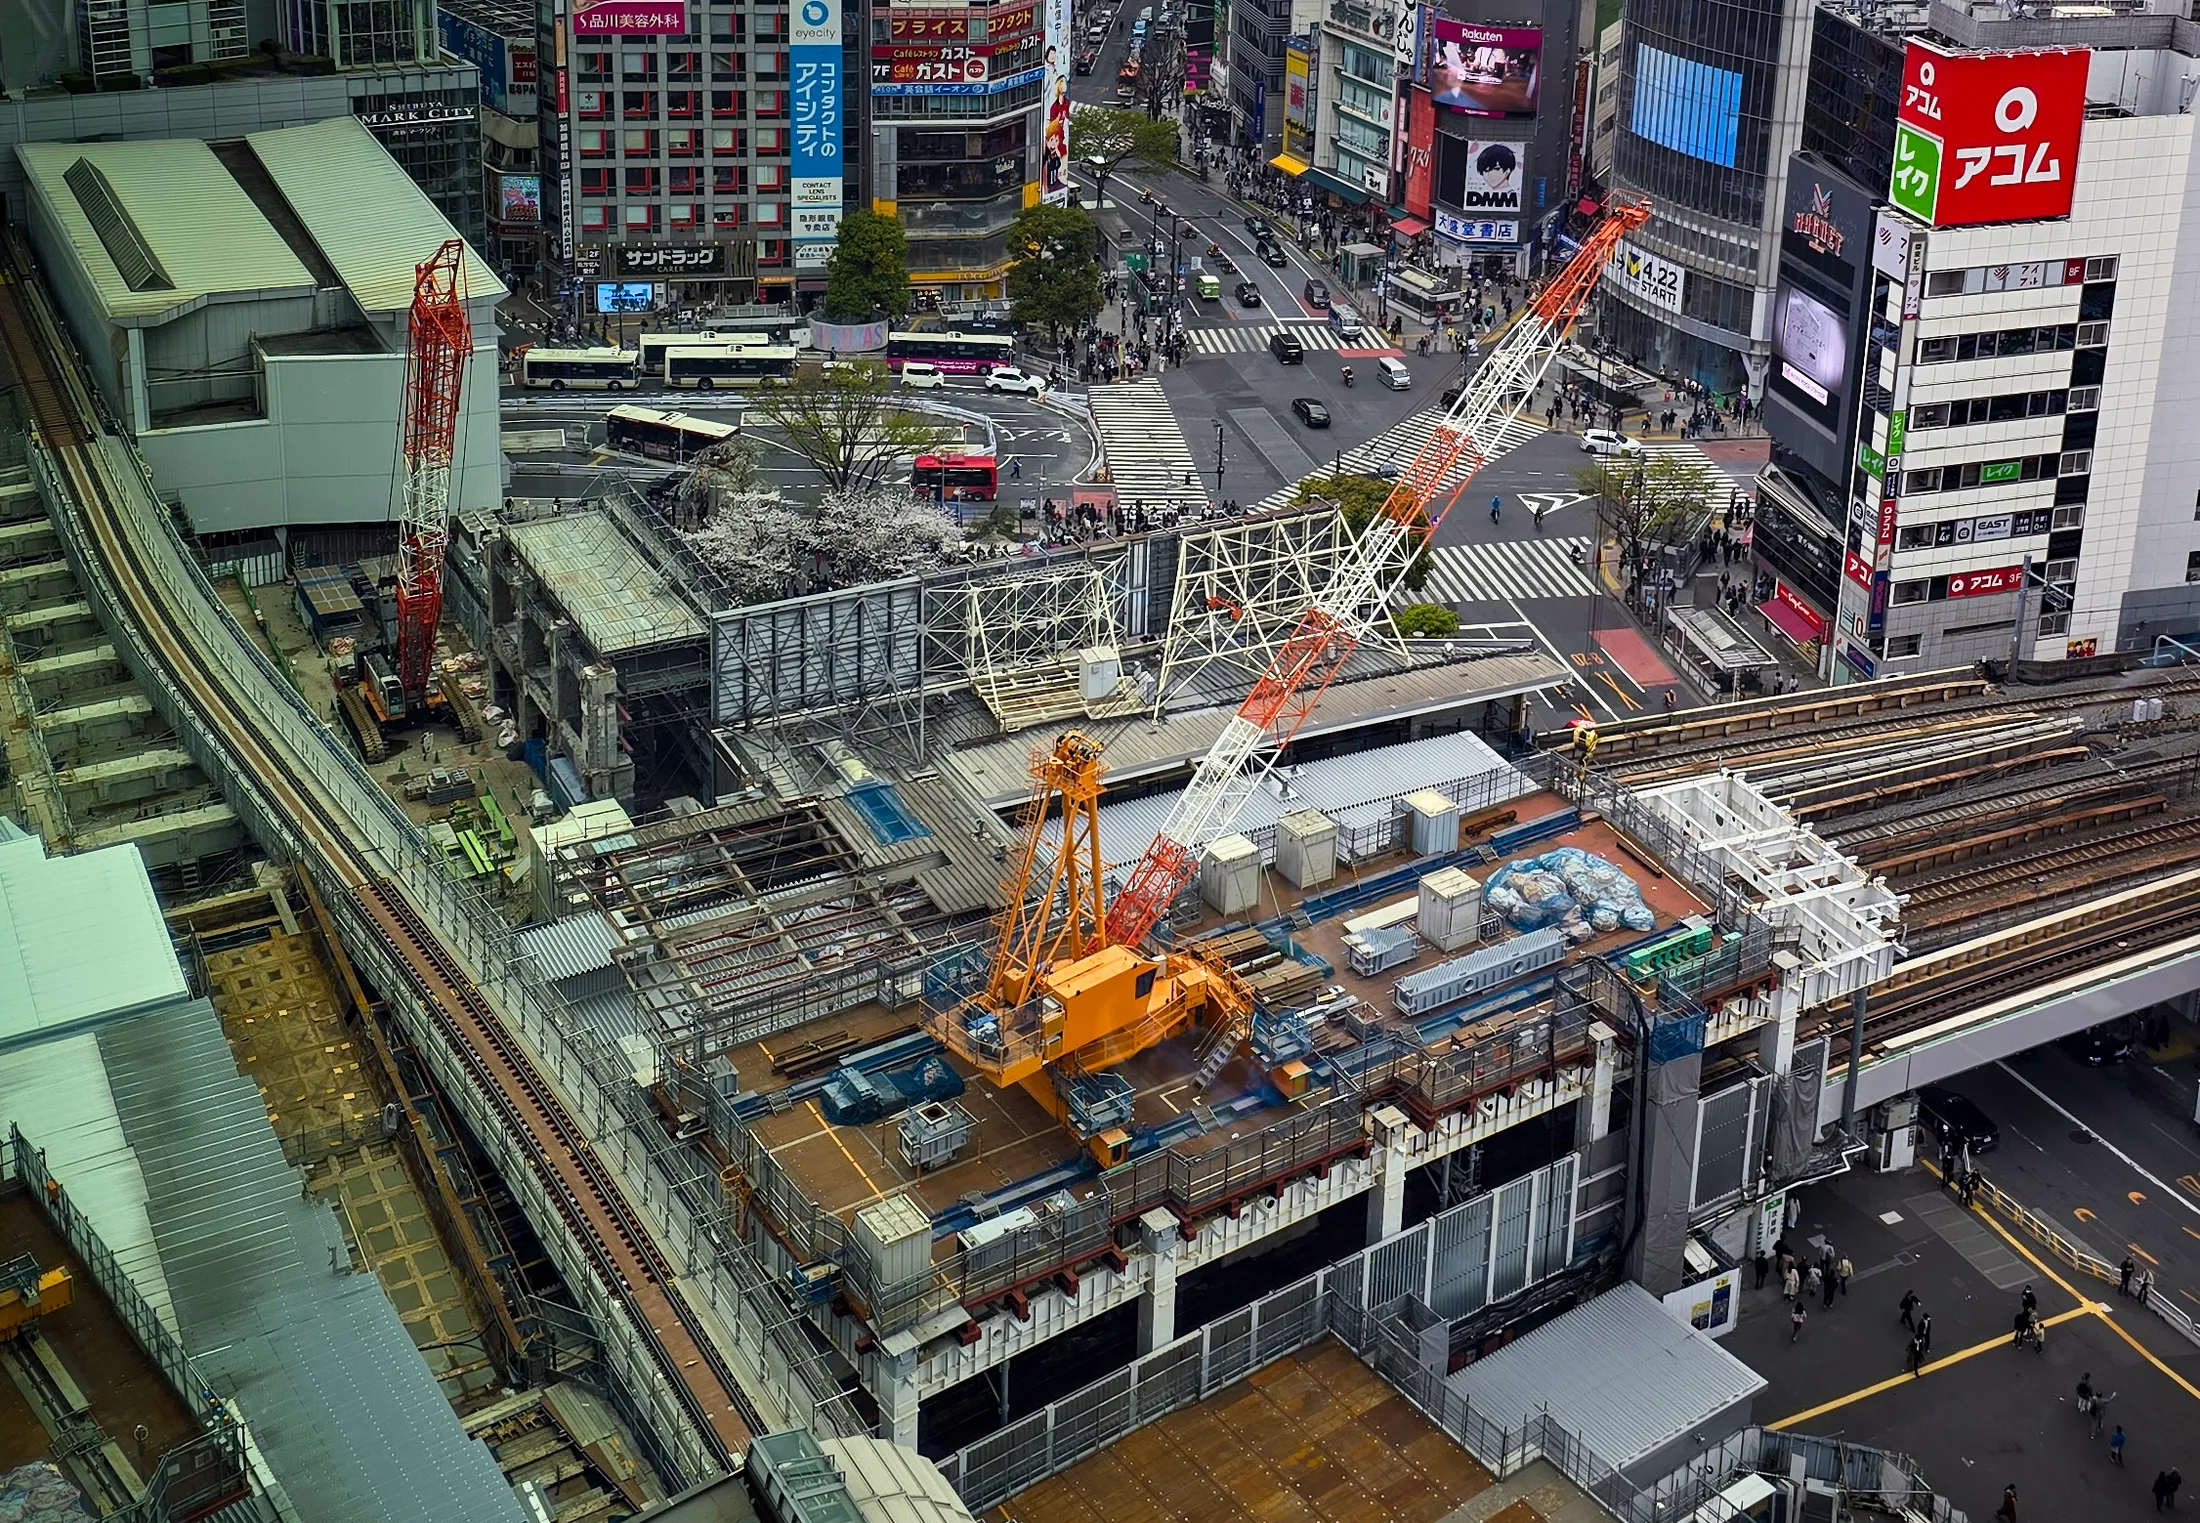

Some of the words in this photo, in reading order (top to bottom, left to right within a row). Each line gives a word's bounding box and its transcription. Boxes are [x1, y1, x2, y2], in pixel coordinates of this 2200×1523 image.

[590, 13, 679, 28] 品川美容外科
[893, 20, 965, 34] プライス
[988, 10, 1031, 33] コンタクト
[795, 28, 835, 40] eyecity
[1020, 34, 1041, 50] ガスト
[1461, 28, 1503, 42] Rakuten
[940, 47, 976, 60] ガスト
[873, 65, 890, 76] 7F
[916, 63, 960, 80] ガスト
[904, 85, 970, 94] 英会話イーオン
[389, 101, 443, 111] SHIBUYA
[796, 63, 818, 157] アイシティ
[821, 63, 836, 157] コンタクトの
[1906, 84, 1941, 121] アコム
[362, 112, 419, 124] MARK
[428, 107, 475, 118] CITY
[1955, 142, 2061, 190] アコム
[1466, 191, 1518, 207] DMM
[1439, 215, 1513, 237] 大盛堂書店
[626, 250, 714, 265] サンドラッグ
[1912, 243, 1922, 271] ビル
[1643, 261, 1678, 291] 4.22
[1641, 280, 1677, 306] START!
[1893, 415, 1902, 438] レイク
[1986, 465, 2013, 478] レイク
[1977, 519, 2009, 530] EAST
[1970, 574, 2003, 590] アコム
[2009, 572, 2022, 583] 3F
